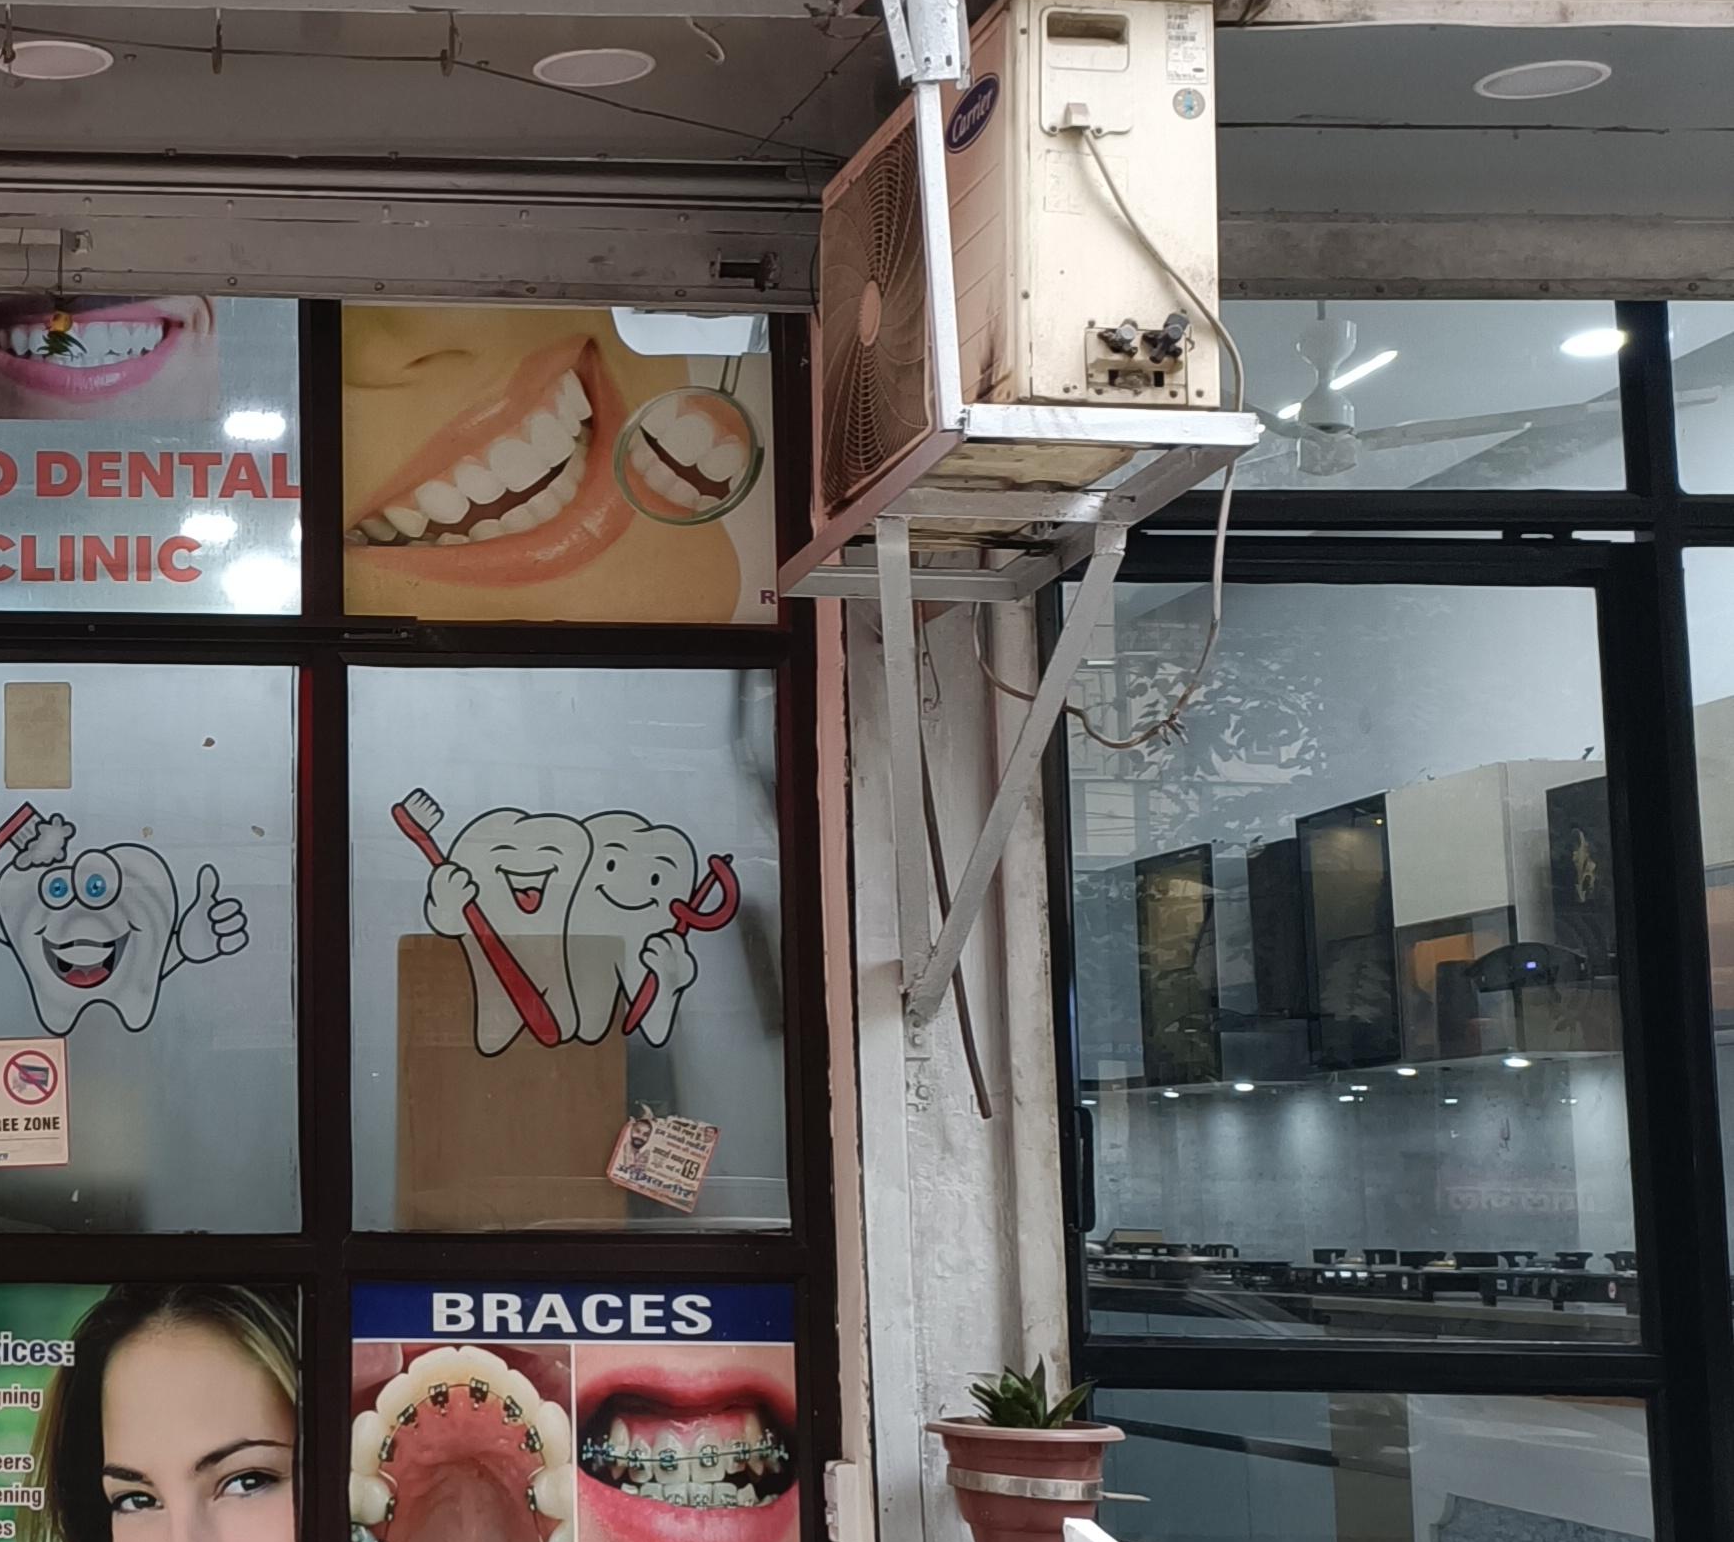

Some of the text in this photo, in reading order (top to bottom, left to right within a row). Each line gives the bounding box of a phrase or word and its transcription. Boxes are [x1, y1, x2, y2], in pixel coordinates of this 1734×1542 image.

[35, 449, 302, 501] DENTAL
[24, 1116, 60, 1130] ZONE
[432, 1293, 714, 1335] BRACES
